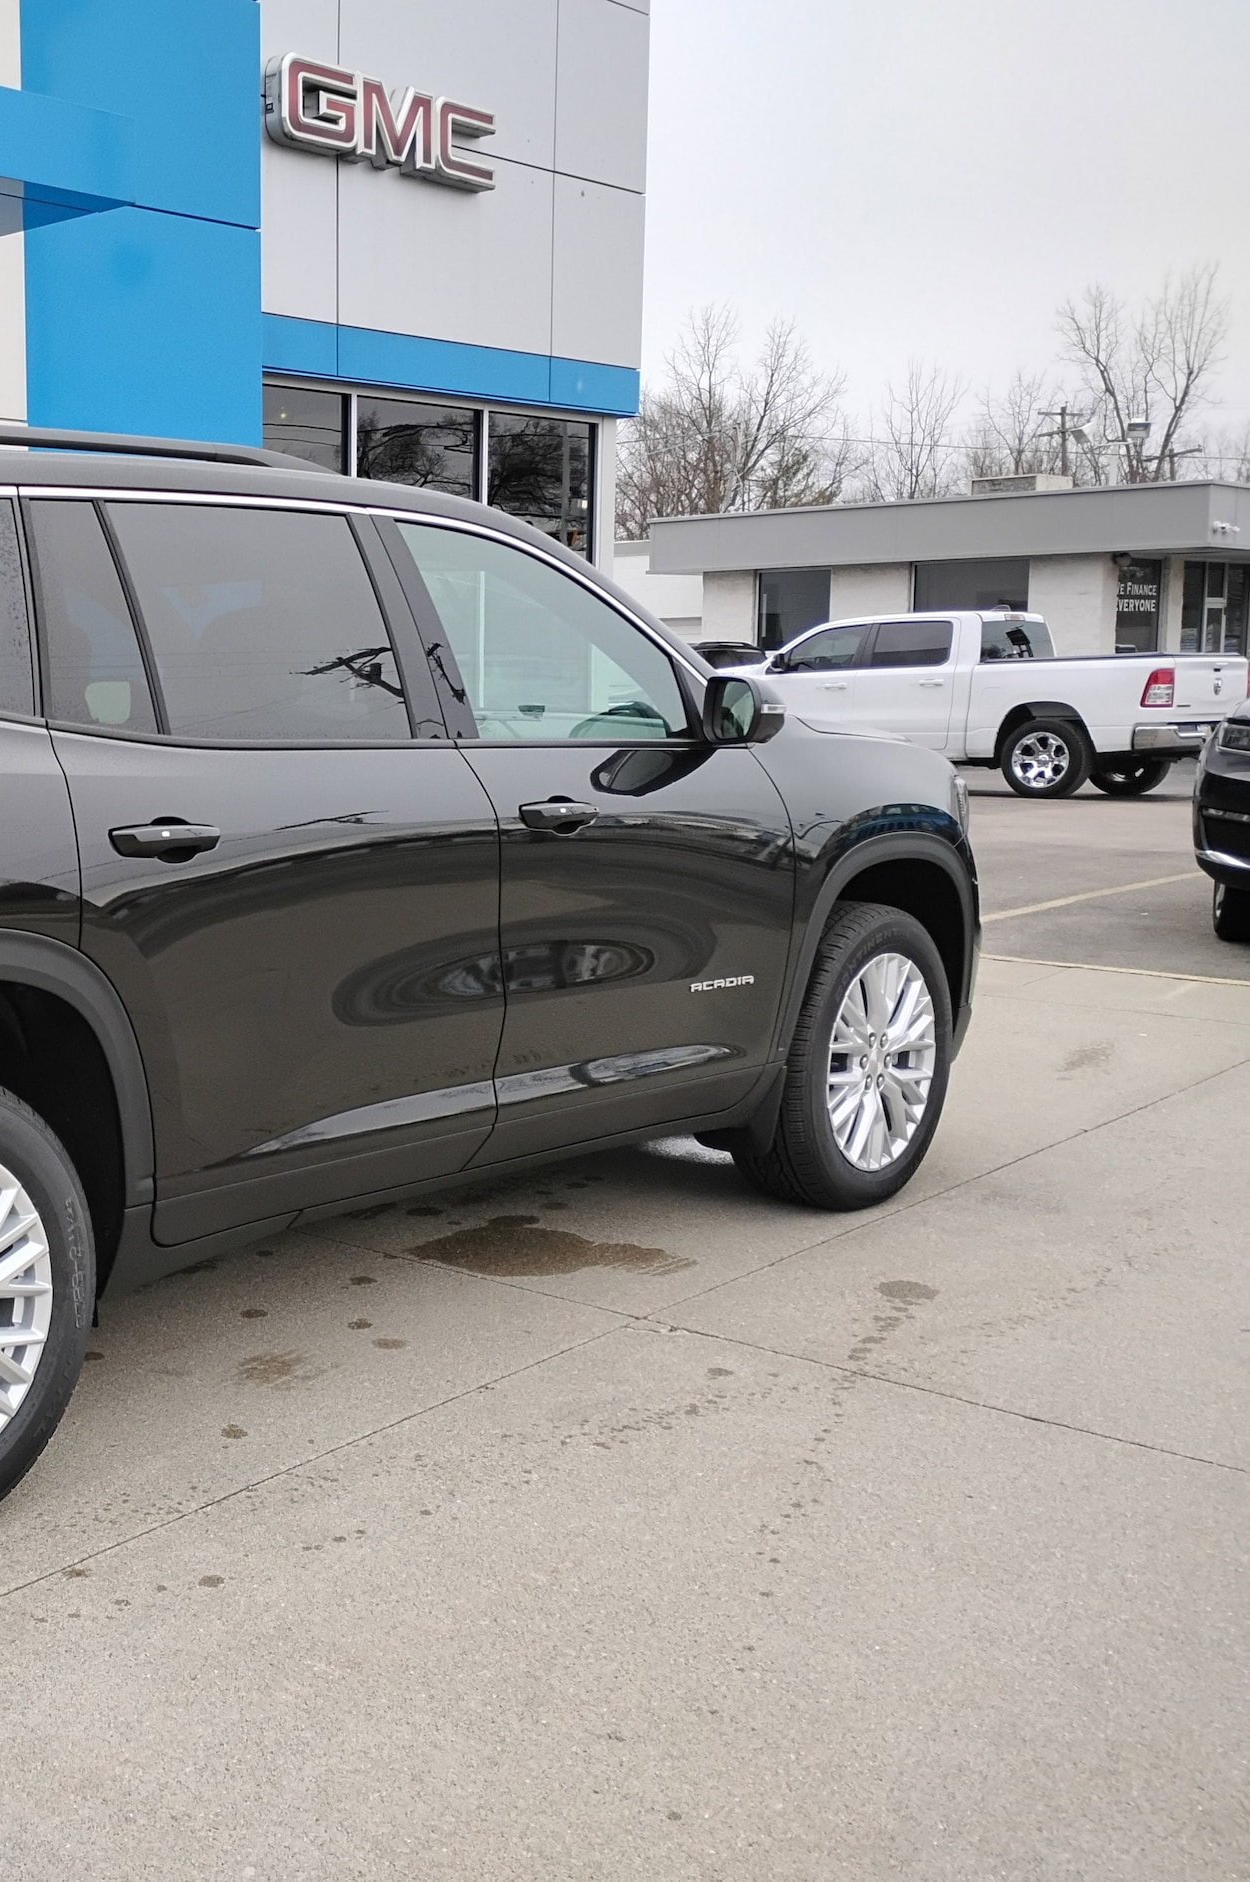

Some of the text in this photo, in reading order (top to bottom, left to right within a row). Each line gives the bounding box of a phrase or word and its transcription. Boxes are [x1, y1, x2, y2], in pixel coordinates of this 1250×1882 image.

[266, 52, 497, 193] GMC
[1127, 582, 1157, 596] FINANCE
[1117, 599, 1156, 612] VERYONE
[689, 975, 755, 993] ACADIA
